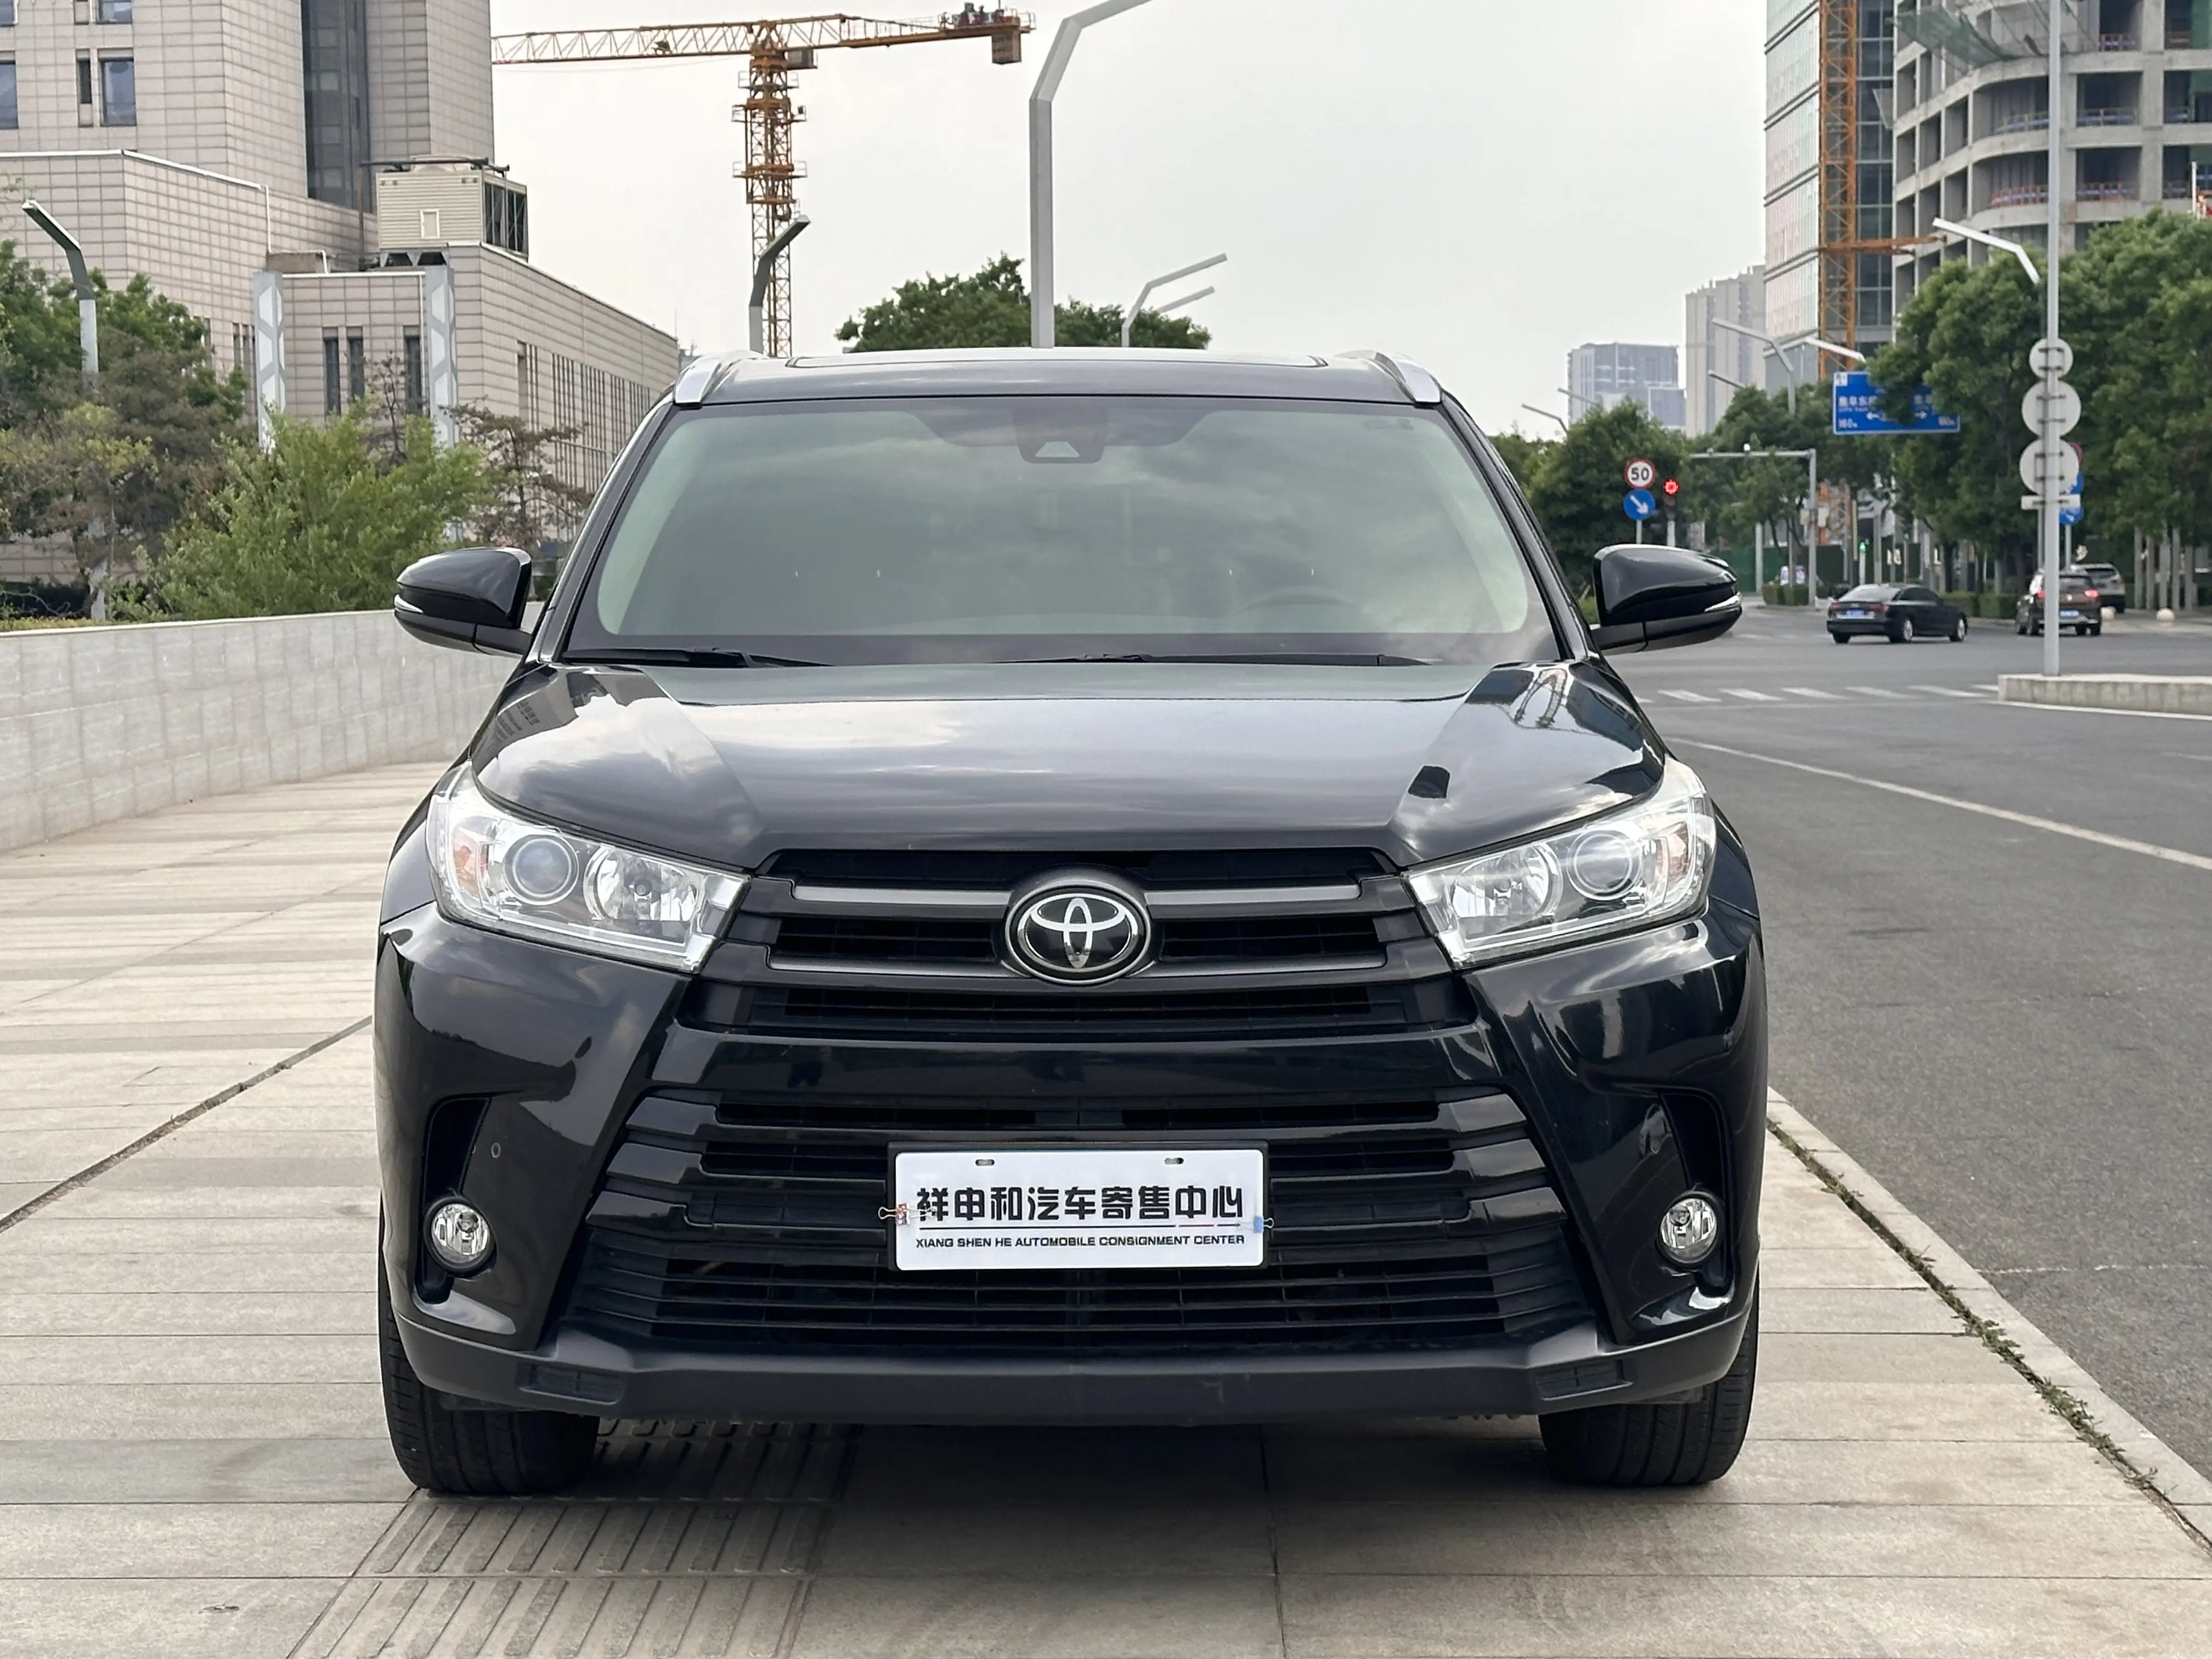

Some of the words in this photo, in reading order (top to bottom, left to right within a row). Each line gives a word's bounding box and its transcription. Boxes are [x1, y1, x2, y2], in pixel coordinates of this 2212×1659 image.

[1630, 467, 1650, 481] 50
[917, 1186, 1243, 1221] 祥申和汽车寄售中心
[916, 1239, 953, 1248] XIANG
[957, 1238, 991, 1247] SHEN
[995, 1238, 1012, 1246] HE
[1015, 1237, 1095, 1246] AUTOMOBILE
[1099, 1236, 1190, 1245] CONSIGNMENT
[1194, 1235, 1244, 1244] CENTER
